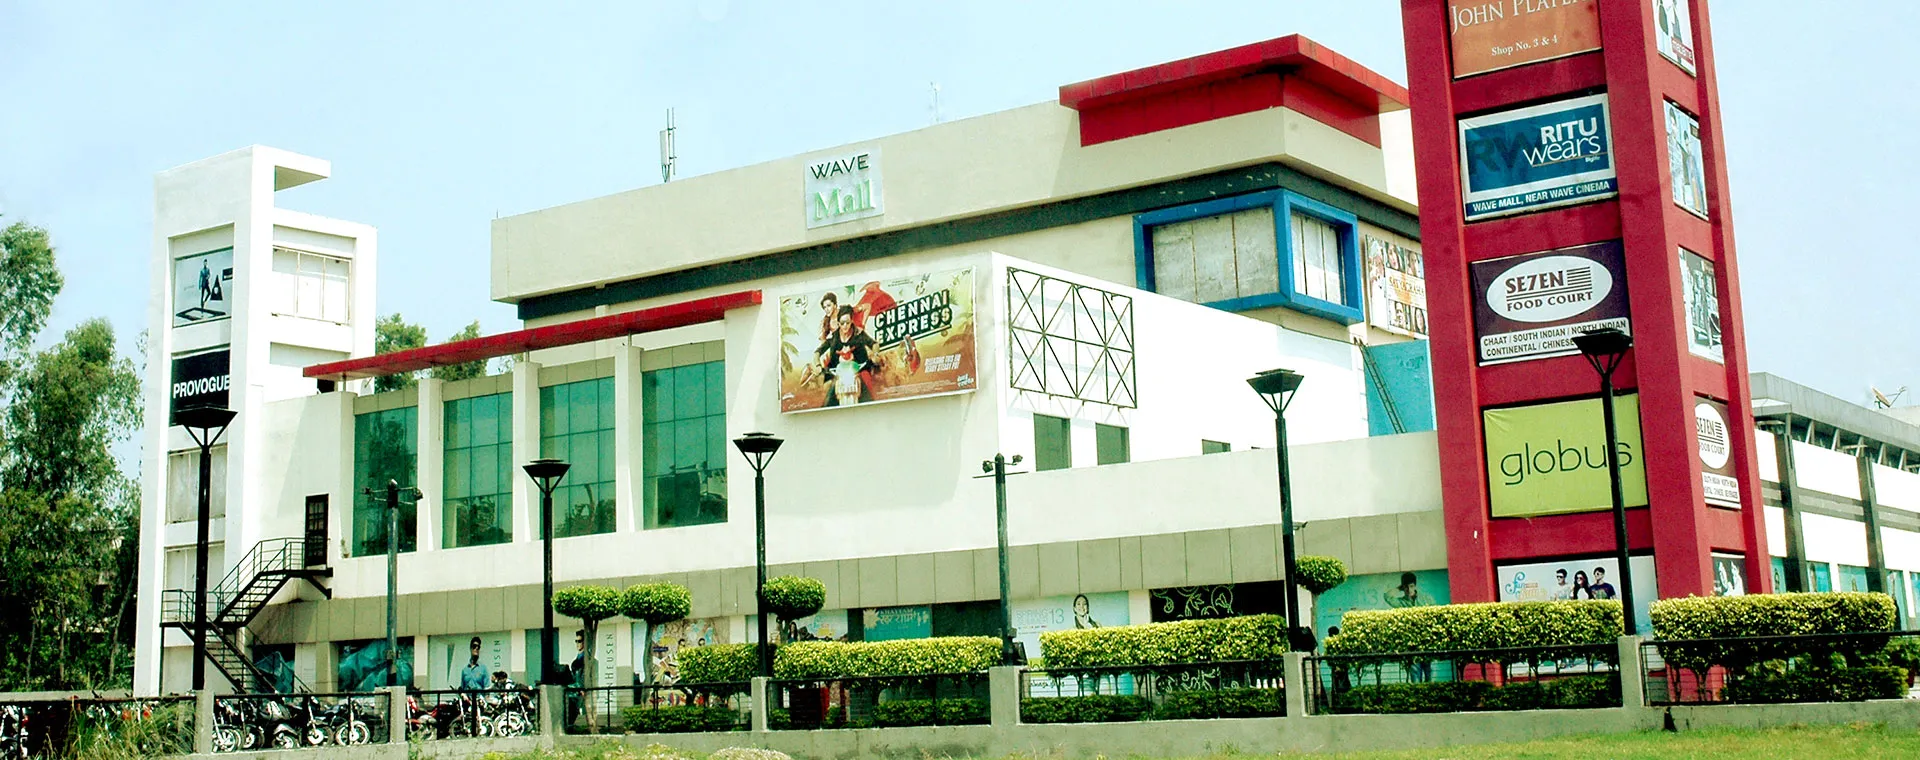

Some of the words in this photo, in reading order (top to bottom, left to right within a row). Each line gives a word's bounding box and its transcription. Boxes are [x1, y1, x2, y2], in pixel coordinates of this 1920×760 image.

[1451, 1, 1504, 35] JOHN
[1491, 45, 1514, 56] Shop
[1515, 41, 1532, 51] No.
[1533, 39, 1539, 48] 3
[1541, 37, 1550, 46] &
[1552, 34, 1558, 43] 4
[1540, 117, 1598, 145] RITU
[1523, 135, 1601, 166] wears
[810, 154, 869, 179] WAVE
[813, 179, 876, 221] Mall
[1472, 200, 1497, 212] WAVE
[1498, 196, 1524, 209] MALL,
[1525, 191, 1548, 203] NEAR
[1549, 187, 1574, 199] WAVE
[1575, 181, 1610, 194] CINEMA
[1505, 270, 1565, 295] SE7EN
[875, 290, 950, 329] CHENNAI
[1507, 299, 1543, 312] FOOD
[1547, 291, 1593, 306] COURT
[875, 308, 951, 344] EXPRESS
[1483, 336, 1508, 347] CHAAT
[1513, 332, 1539, 343] SOUTH
[1540, 328, 1566, 340] INDIAN
[1571, 324, 1598, 335] NORTH
[1486, 343, 1537, 357] CONTINENTAL
[1542, 338, 1575, 350] CHINESE
[173, 374, 230, 399] PROVOGUE
[1500, 439, 1633, 486] globus
[1051, 607, 1065, 625] 13
